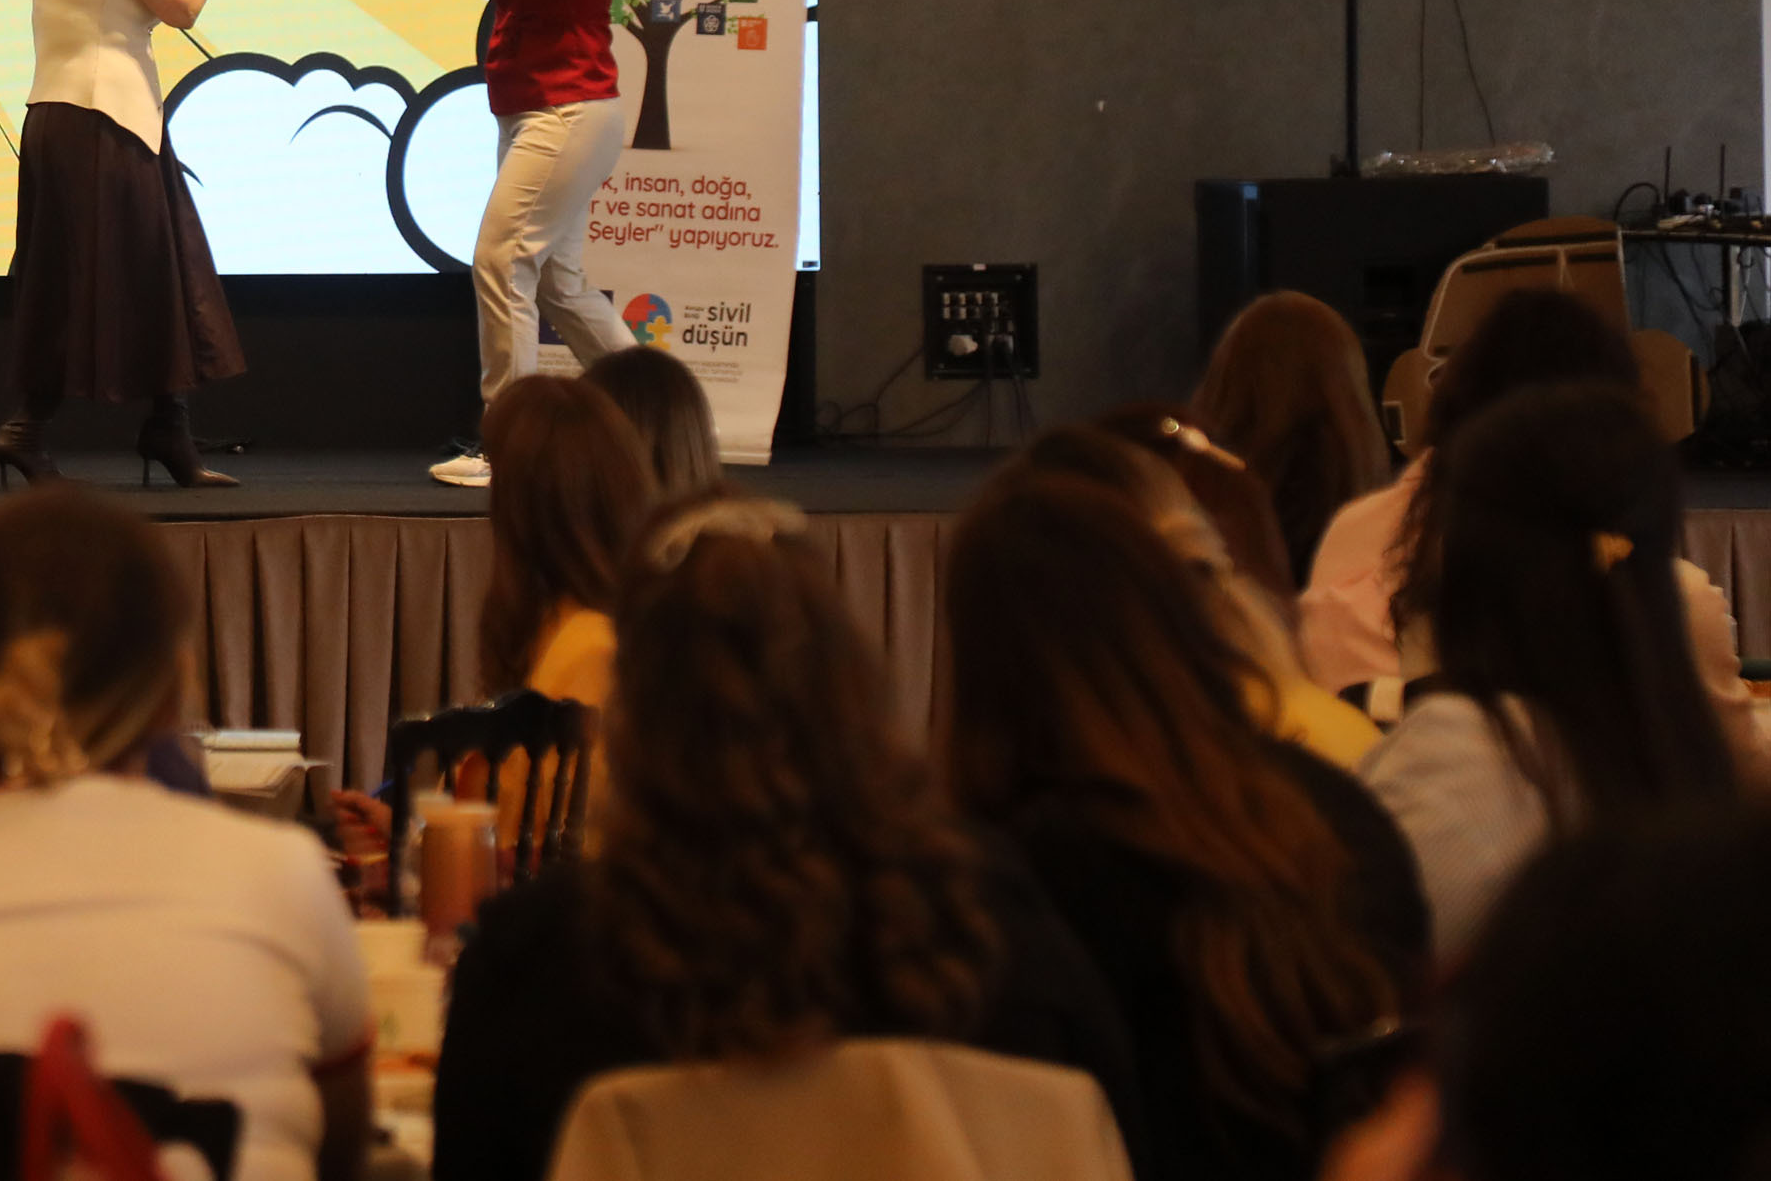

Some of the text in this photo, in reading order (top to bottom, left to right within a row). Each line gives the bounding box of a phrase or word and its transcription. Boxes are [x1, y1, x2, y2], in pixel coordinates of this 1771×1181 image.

[625, 172, 685, 196] insan,
[691, 175, 752, 200] doğa,
[606, 200, 630, 216] ve
[636, 202, 696, 220] sanat
[702, 202, 761, 222] adına
[669, 228, 779, 251] yapıyoruz.
[707, 301, 752, 324] sivil
[682, 324, 749, 353] düşün
